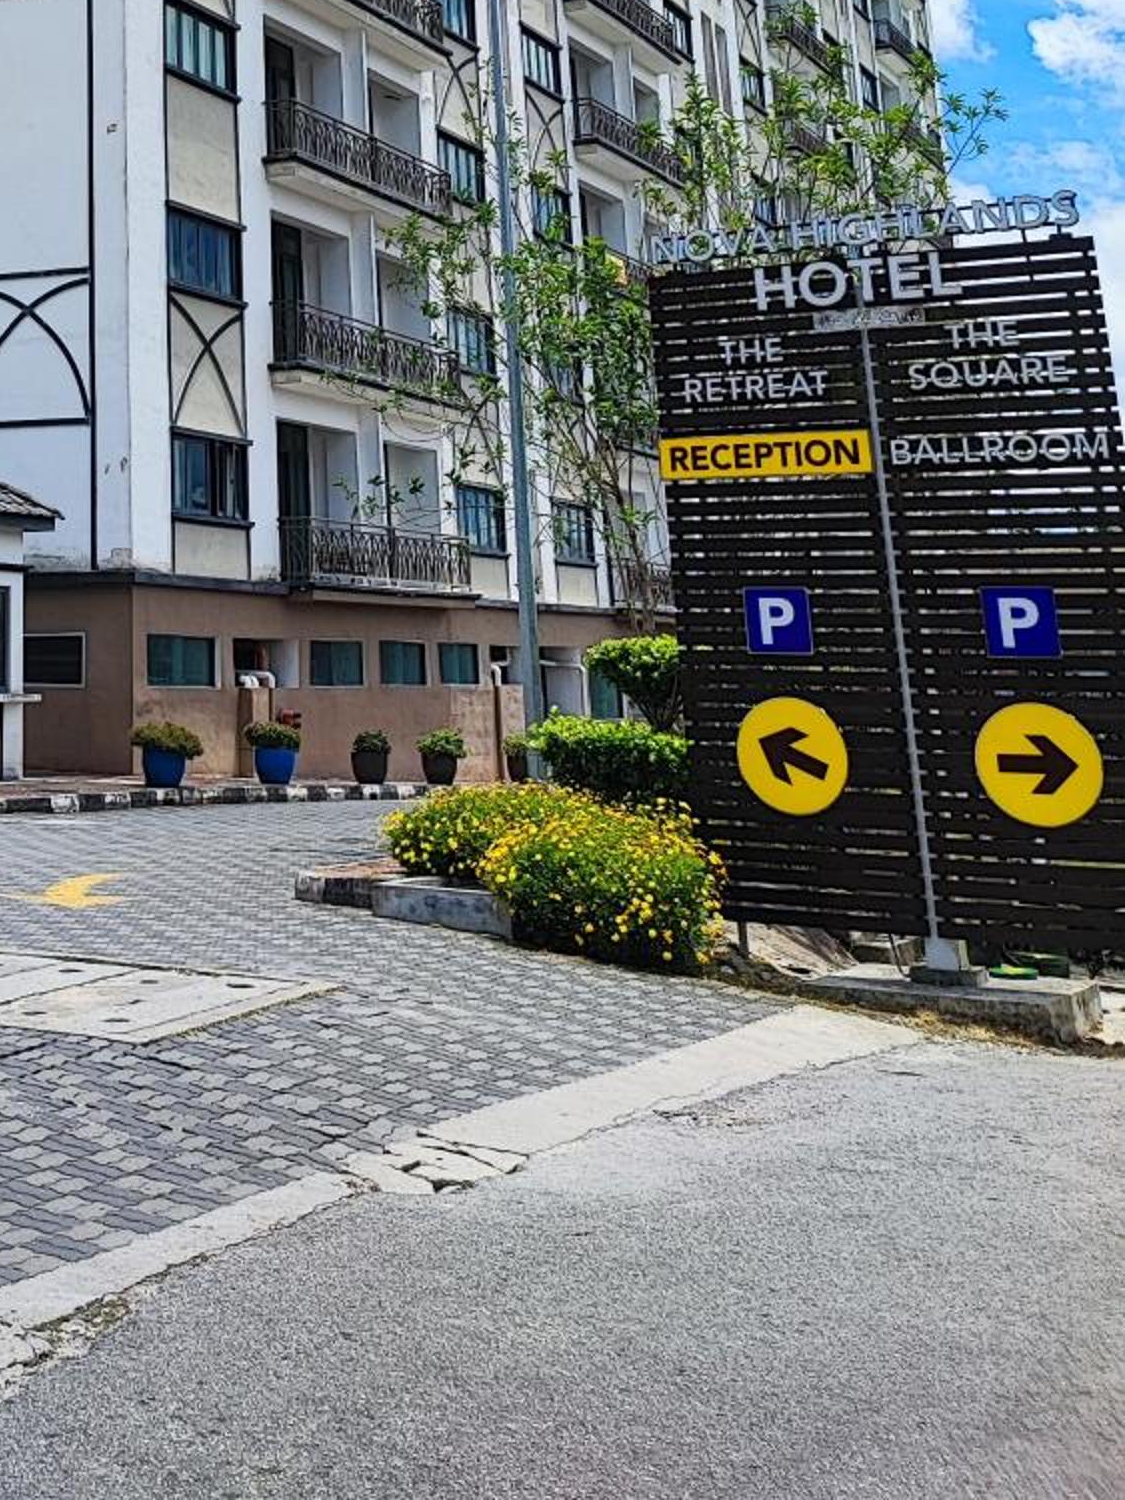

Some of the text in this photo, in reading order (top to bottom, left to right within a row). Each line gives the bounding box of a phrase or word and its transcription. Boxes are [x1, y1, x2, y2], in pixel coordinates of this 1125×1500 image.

[651, 190, 1080, 263] NOVA HIGHLANDS
[753, 251, 963, 311] HOTEL
[719, 336, 784, 366] THE
[944, 320, 1020, 350] THE
[683, 370, 829, 403] RETREAT
[908, 355, 1071, 390] SQUARE
[669, 437, 861, 472] RECEPTION
[890, 432, 1110, 466] BALLROOM
[758, 597, 795, 645] P
[996, 597, 1040, 649] P
